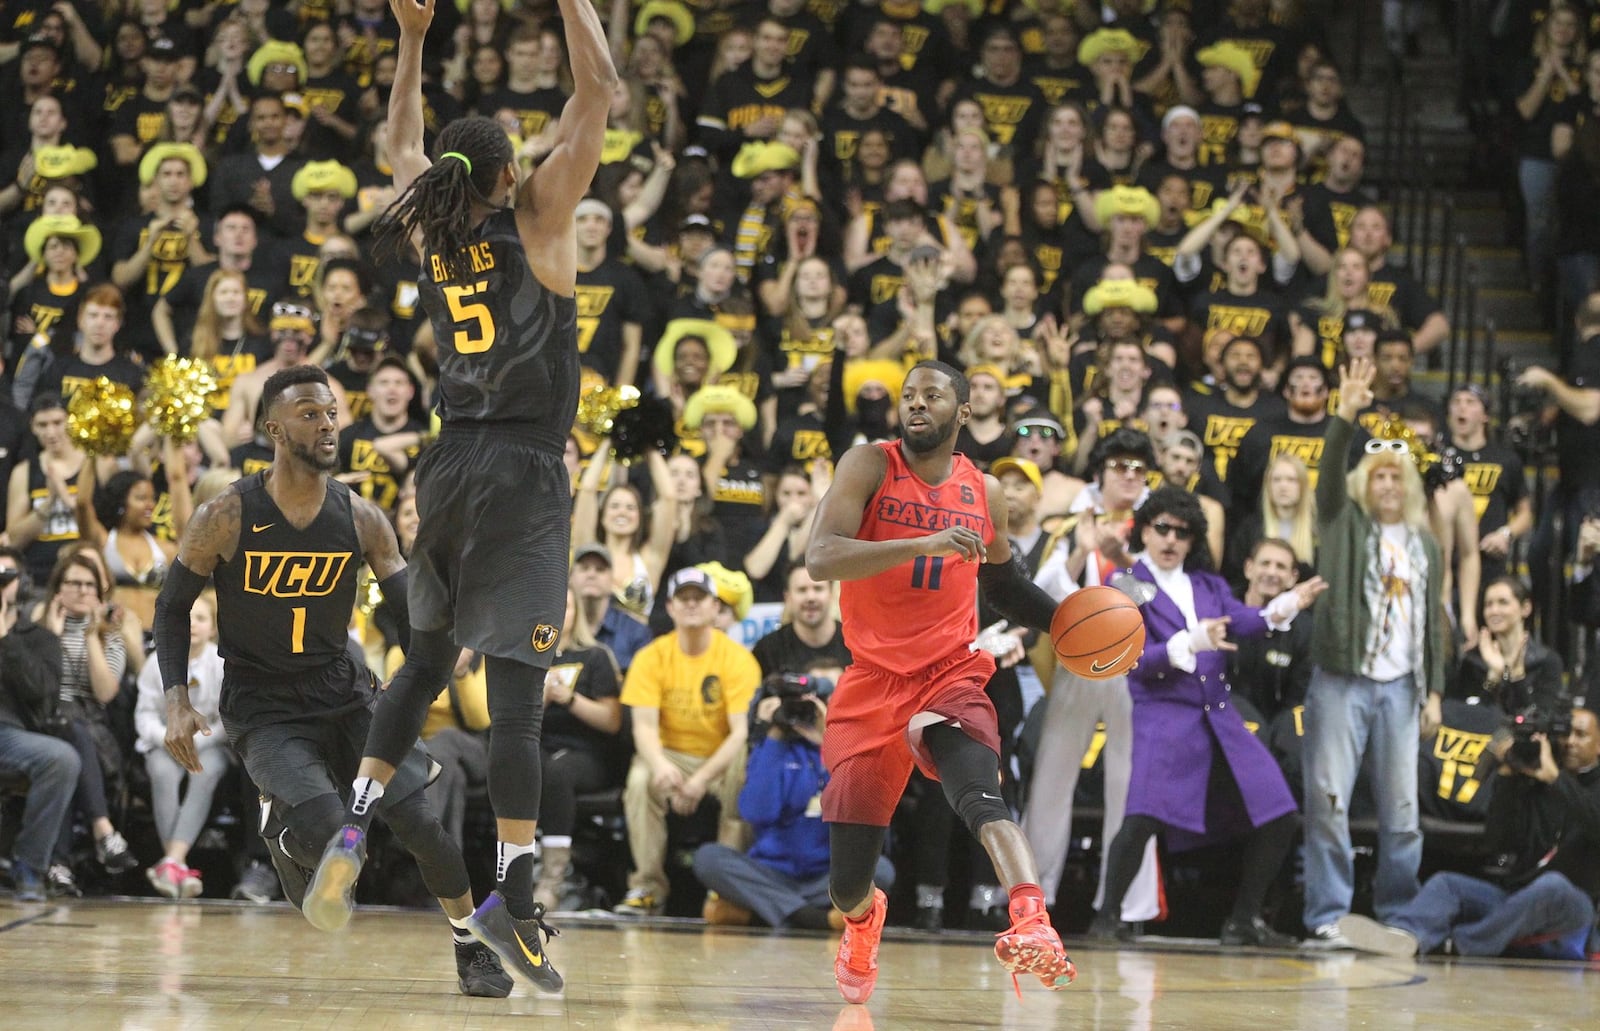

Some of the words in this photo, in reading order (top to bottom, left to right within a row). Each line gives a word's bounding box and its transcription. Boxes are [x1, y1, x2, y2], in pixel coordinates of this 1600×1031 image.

[442, 281, 496, 355] 5
[244, 551, 353, 598] VCU
[911, 555, 944, 591] 11
[291, 607, 307, 654] 1
